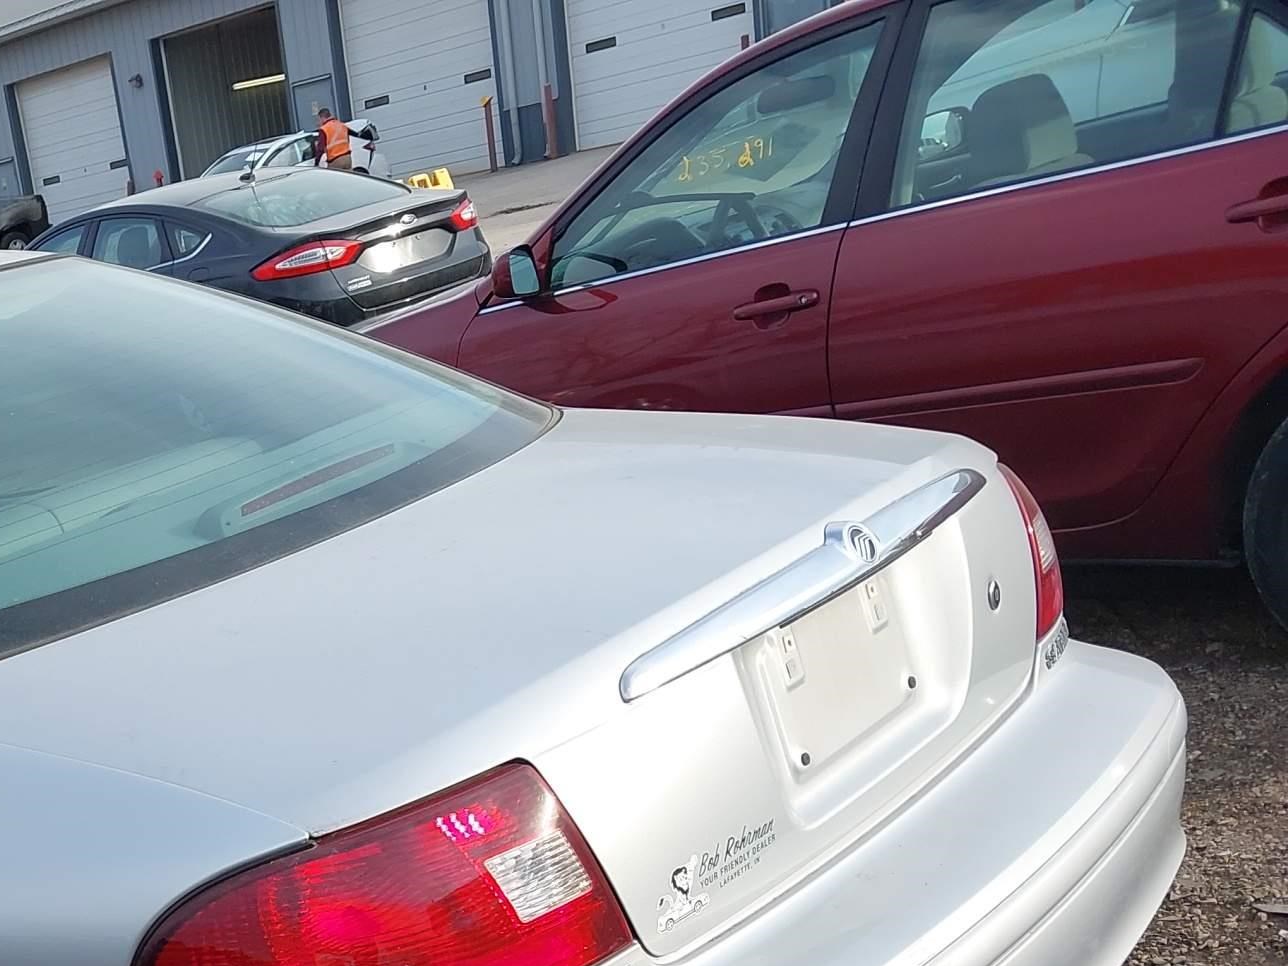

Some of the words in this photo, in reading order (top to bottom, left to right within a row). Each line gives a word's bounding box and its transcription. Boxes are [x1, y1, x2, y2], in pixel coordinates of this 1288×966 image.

[698, 842, 720, 878] Bob
[700, 871, 718, 889] YOUR
[719, 850, 751, 877] FRIENDLY
[752, 833, 776, 856] DEALER
